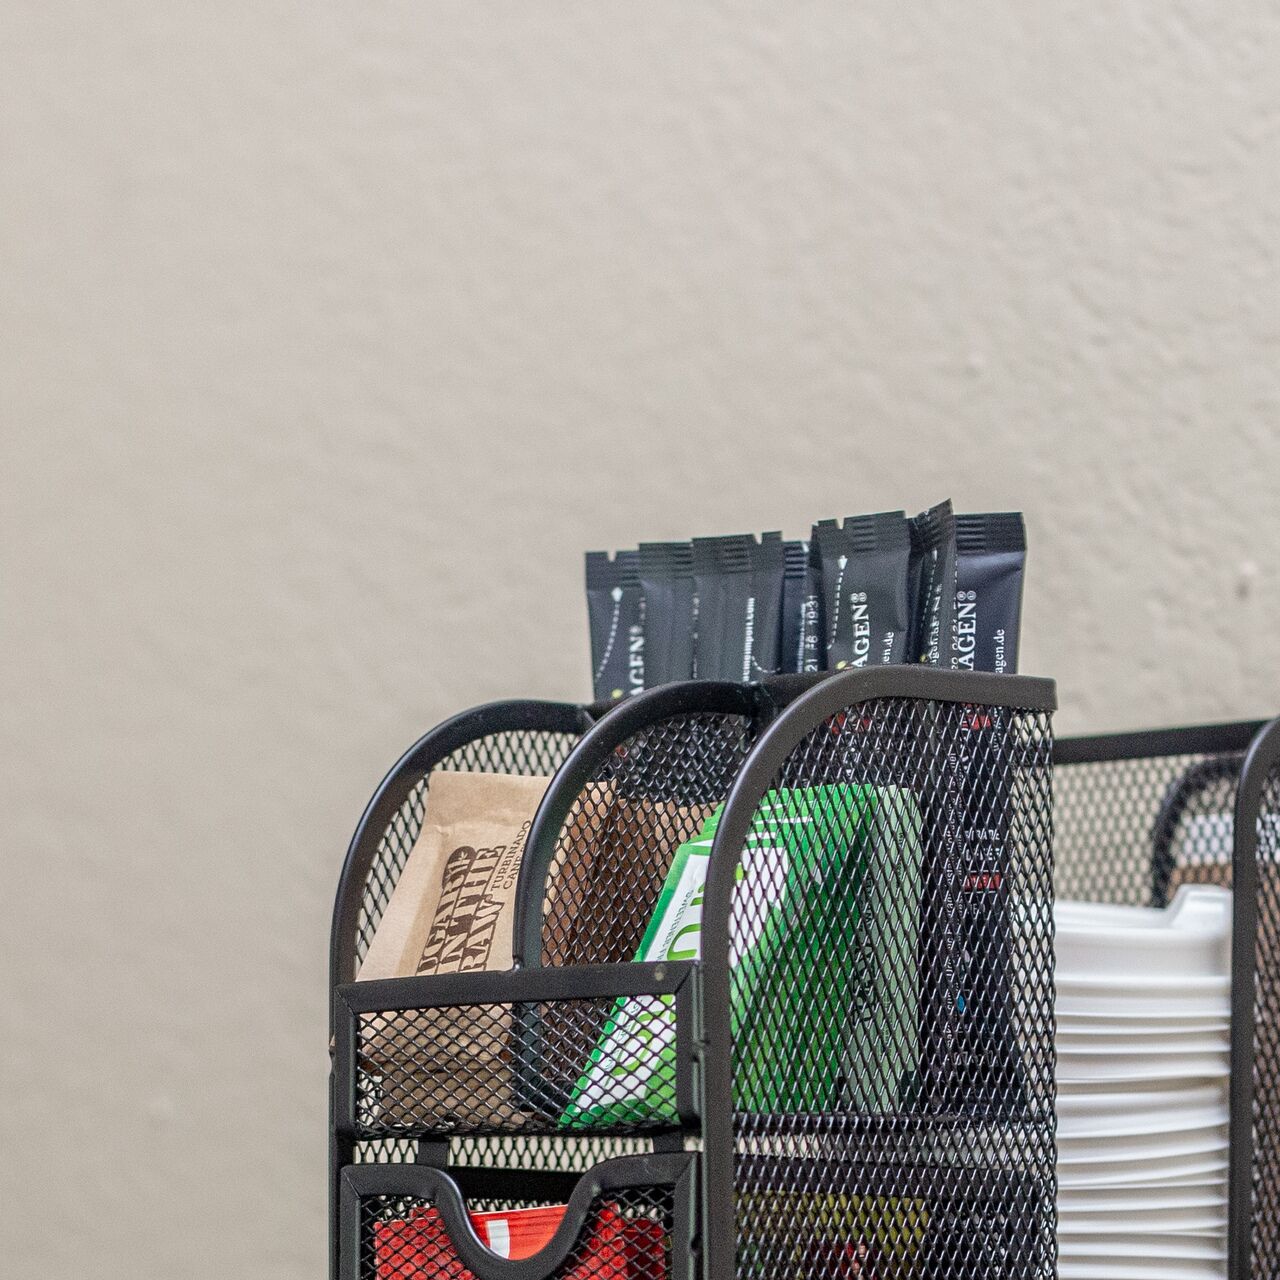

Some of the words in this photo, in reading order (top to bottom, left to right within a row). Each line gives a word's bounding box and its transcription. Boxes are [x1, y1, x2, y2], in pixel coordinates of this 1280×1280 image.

[449, 845, 507, 926] THE
[490, 820, 531, 892] TURBINADO
[436, 930, 470, 974] IN
